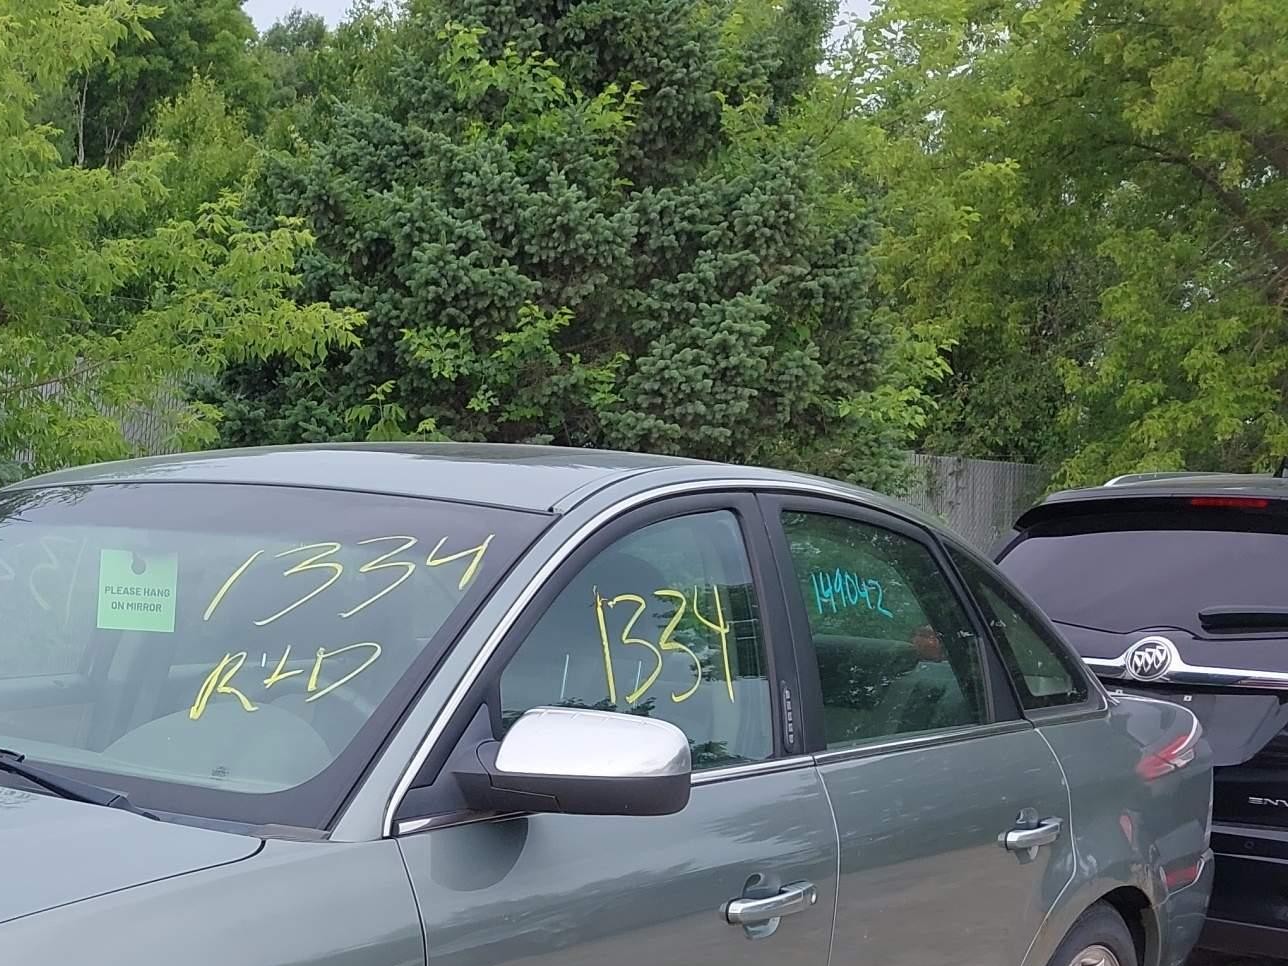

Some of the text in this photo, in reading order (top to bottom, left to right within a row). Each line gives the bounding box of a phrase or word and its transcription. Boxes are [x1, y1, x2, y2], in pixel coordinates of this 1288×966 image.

[104, 585, 171, 598] PLEASE HANG
[203, 533, 496, 626] 1334
[111, 601, 162, 613] ON MIRROR
[592, 583, 735, 705] 1334
